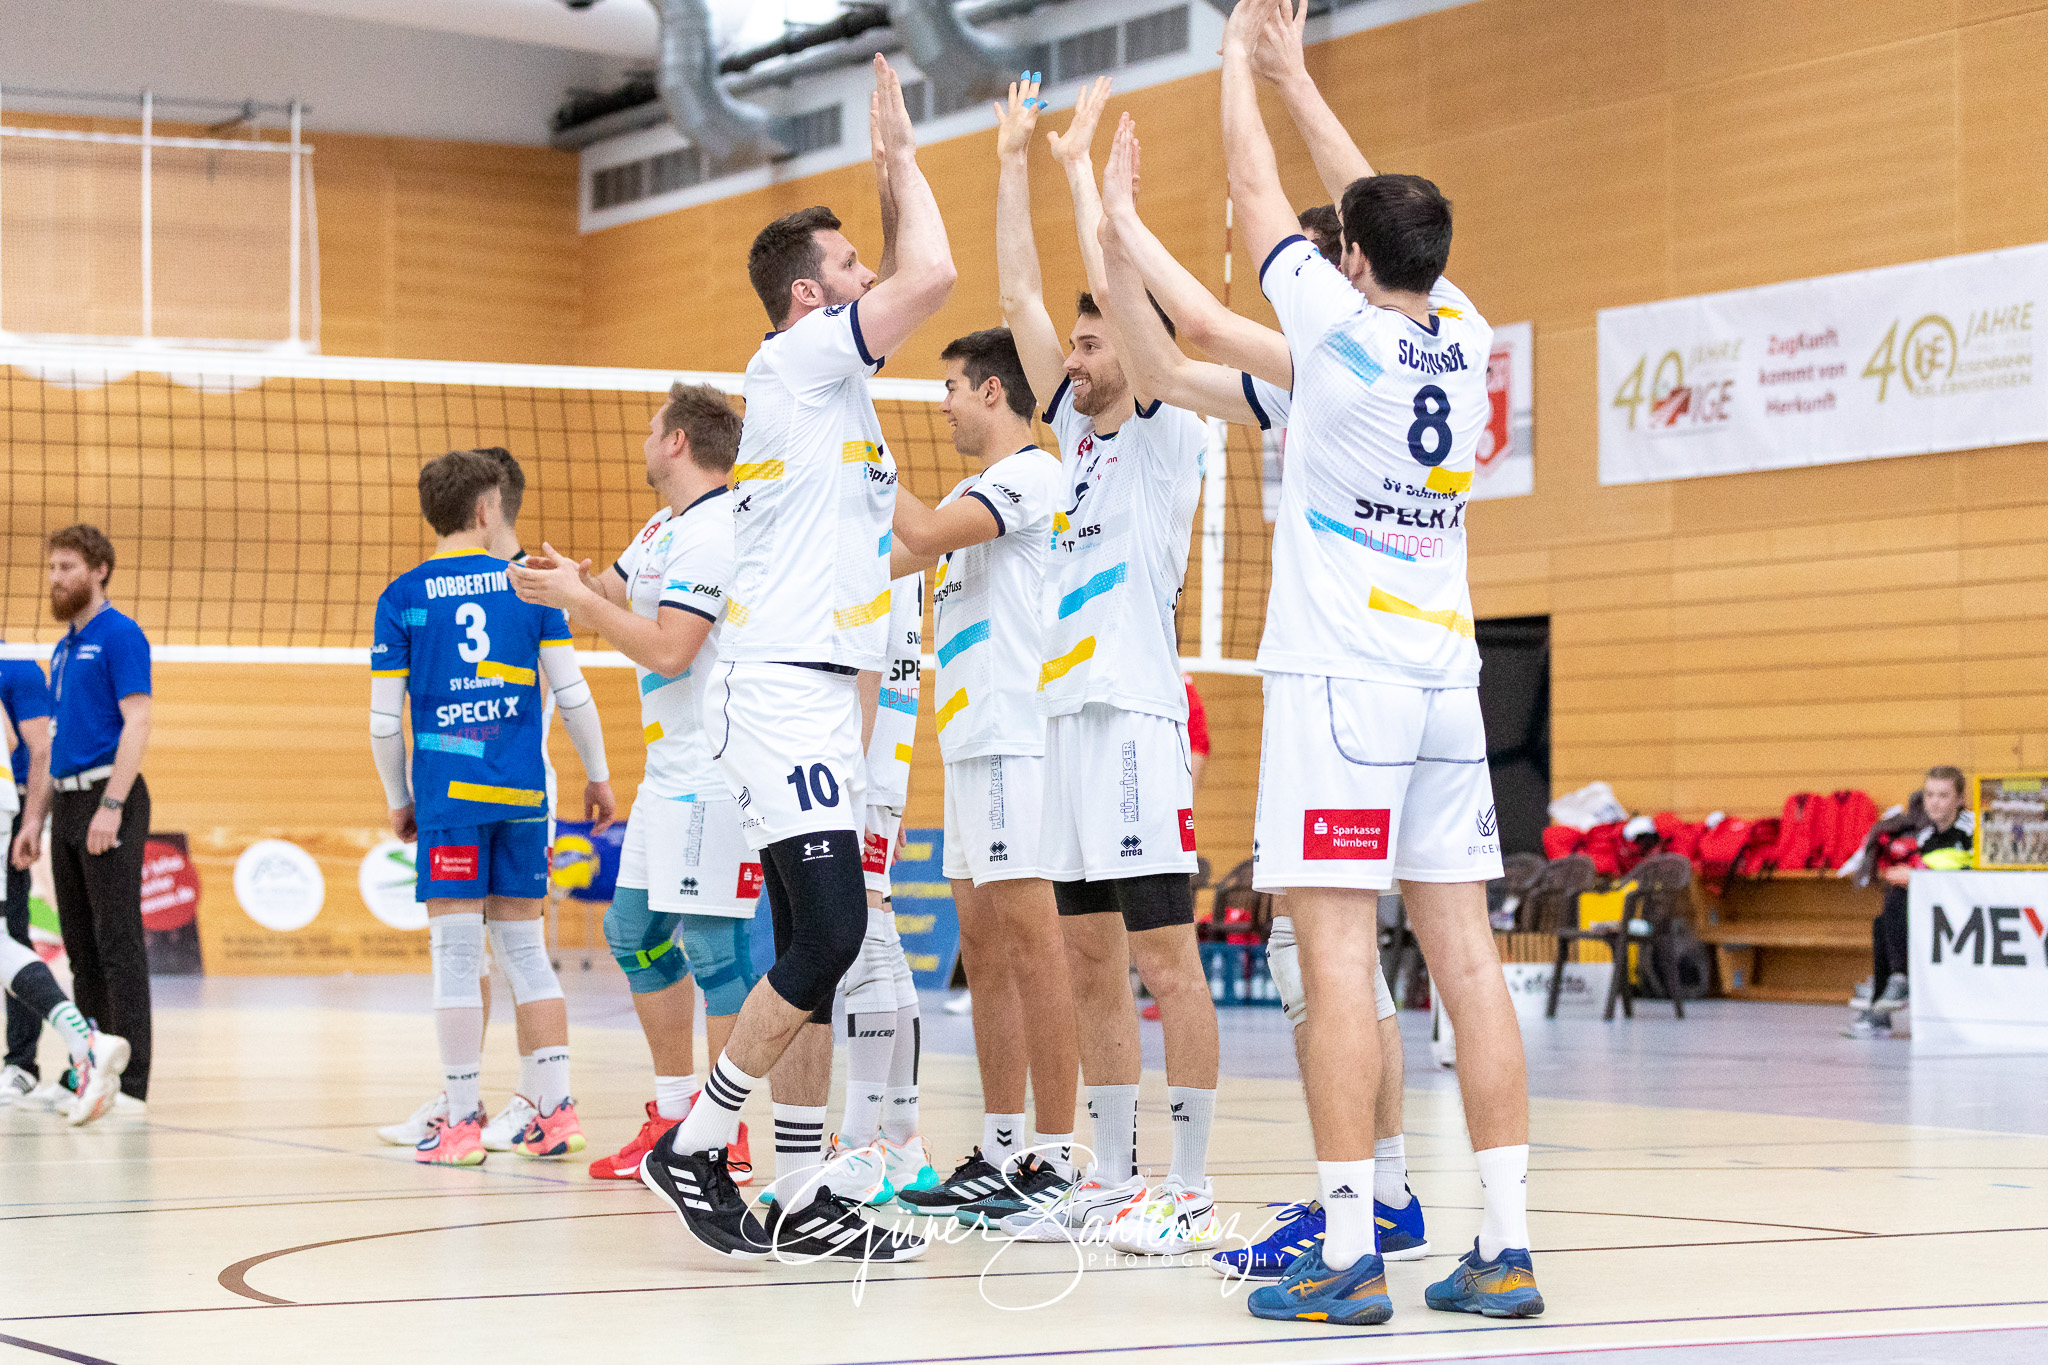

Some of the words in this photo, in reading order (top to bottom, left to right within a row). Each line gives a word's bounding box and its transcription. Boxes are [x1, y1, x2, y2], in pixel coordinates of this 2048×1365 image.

[1963, 302, 2034, 348] JAHRE
[1861, 314, 1957, 402] 40
[1408, 384, 1453, 467] 8
[1355, 498, 1446, 529] SPECK
[425, 571, 508, 600] DOBBERTIN
[692, 584, 722, 598] puls
[455, 602, 491, 664] 3
[449, 677, 462, 692] SV
[436, 699, 501, 727] SPECK
[786, 762, 840, 813] 10
[1332, 825, 1381, 836] Sparkasse
[1333, 837, 1378, 850] Nürnberg
[877, 1029, 896, 1038] cep
